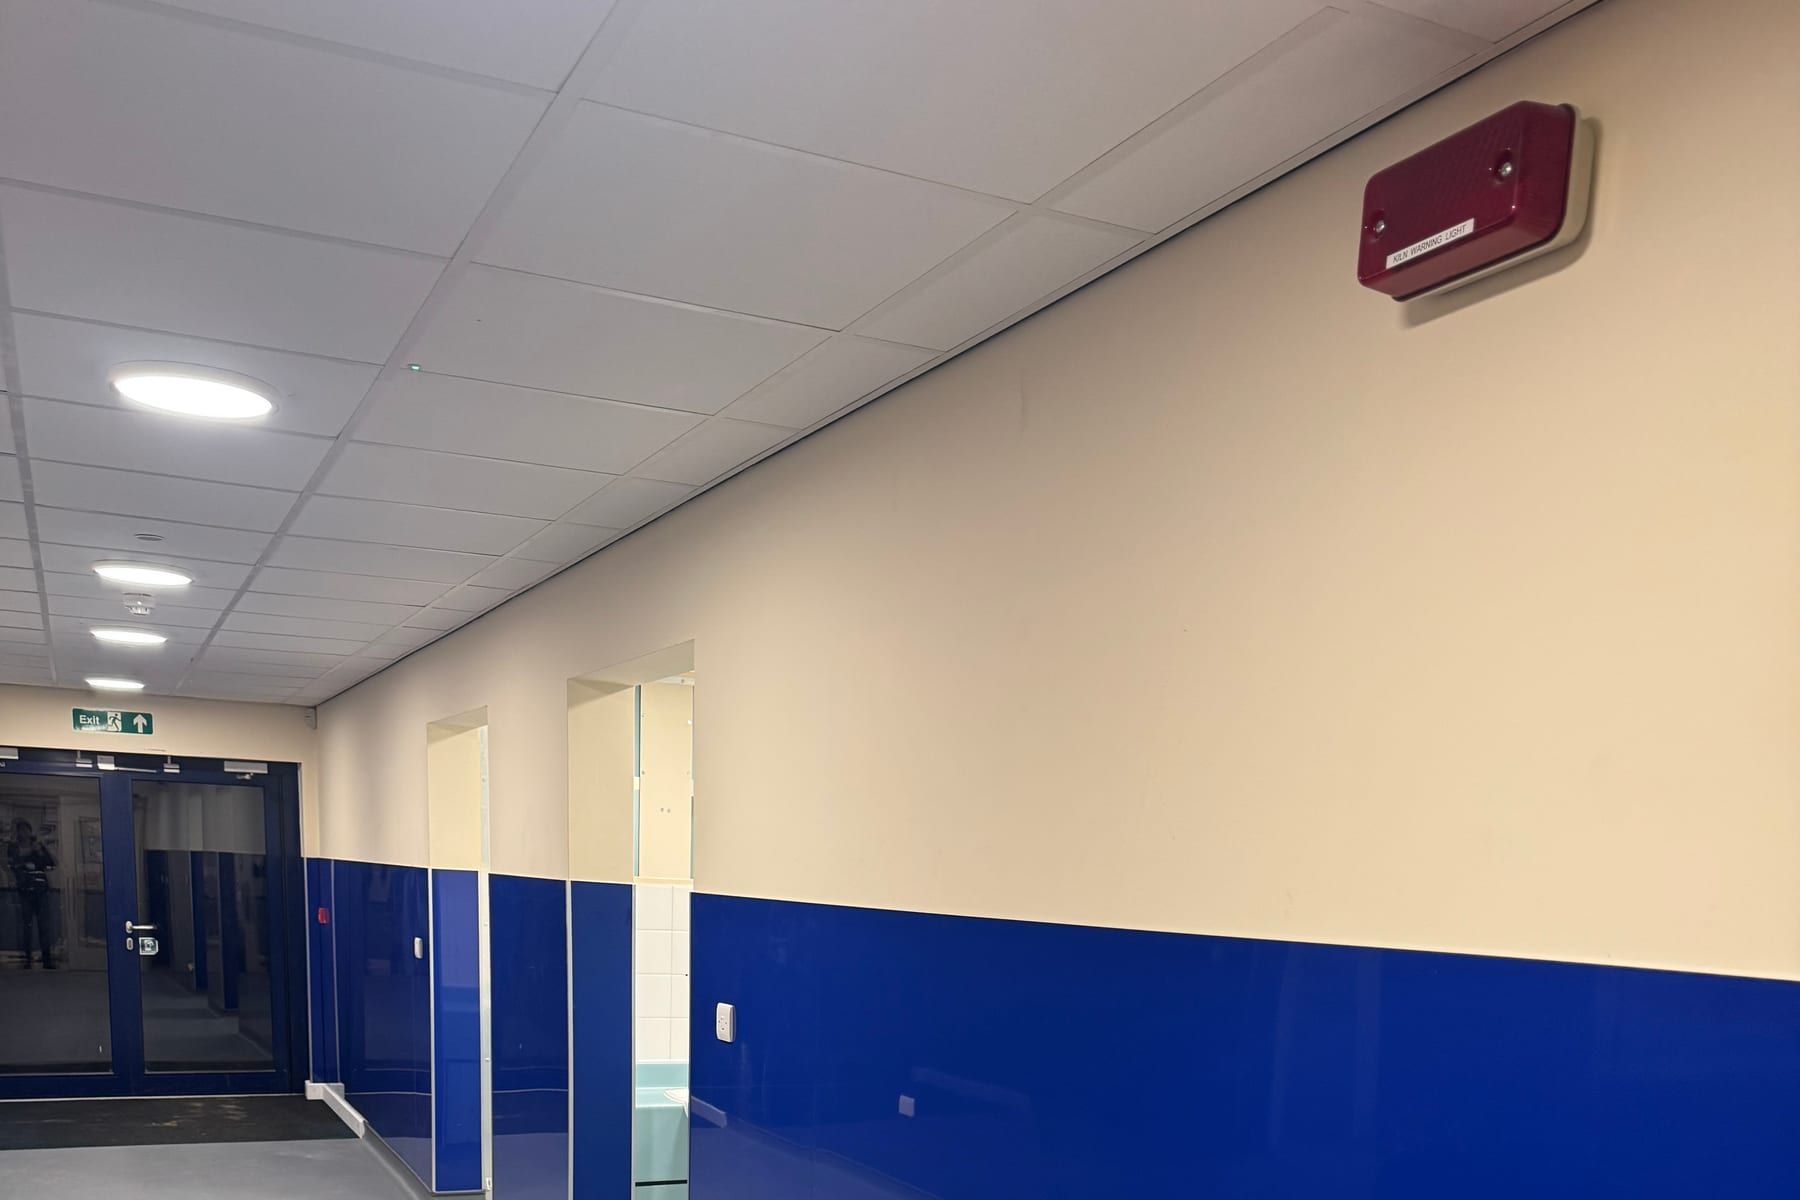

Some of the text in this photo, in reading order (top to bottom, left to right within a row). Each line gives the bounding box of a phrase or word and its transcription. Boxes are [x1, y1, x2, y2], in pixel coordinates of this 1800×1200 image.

[1392, 224, 1467, 263] KILN WARNING LIGHT
[79, 714, 100, 725] Exit
